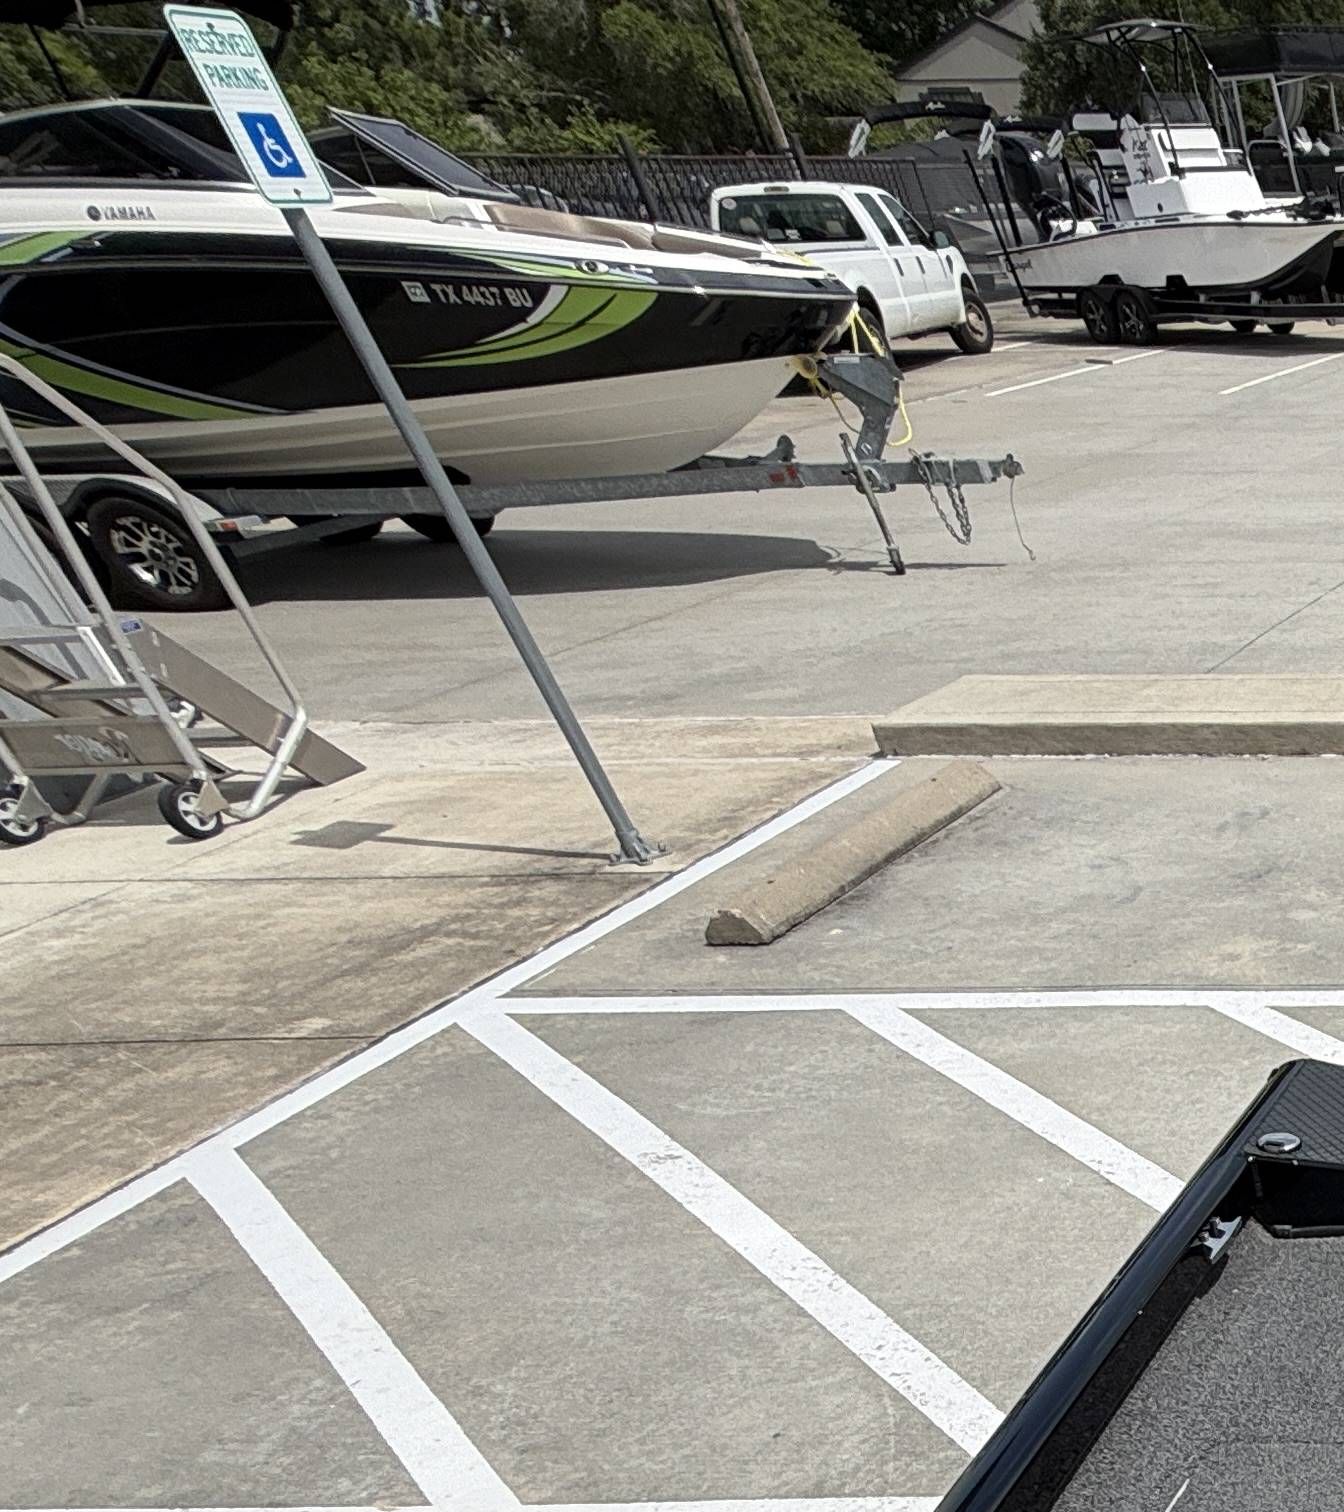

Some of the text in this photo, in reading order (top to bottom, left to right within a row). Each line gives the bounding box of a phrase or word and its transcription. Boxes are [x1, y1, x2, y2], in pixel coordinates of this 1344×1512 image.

[180, 28, 255, 57] RESERVED
[202, 63, 269, 91] PARKING
[103, 206, 156, 220] YAMAHA
[430, 283, 534, 308] TX 4437 BU
